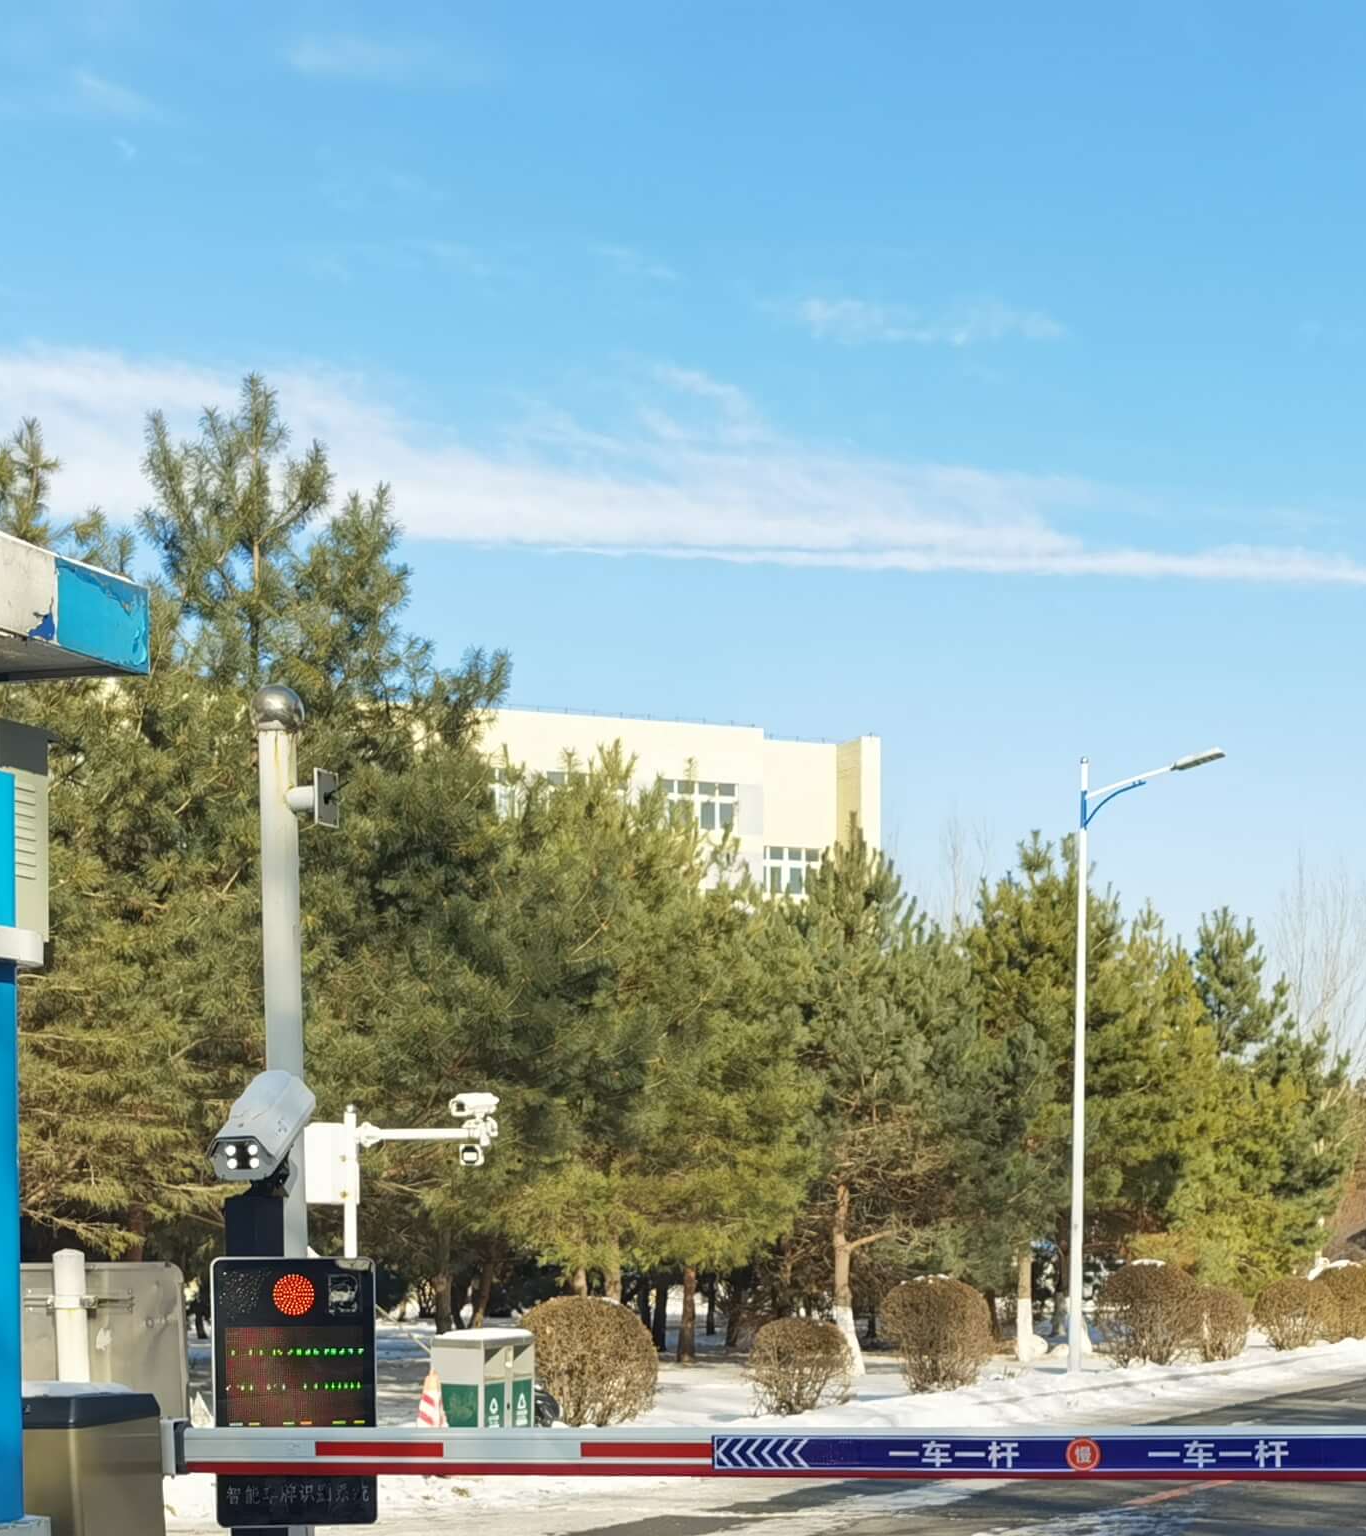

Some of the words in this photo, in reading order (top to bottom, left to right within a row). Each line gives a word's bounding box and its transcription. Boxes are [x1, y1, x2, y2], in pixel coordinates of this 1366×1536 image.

[889, 1440, 1019, 1468] 一车一杆
[1075, 1446, 1093, 1464] 慢
[1148, 1440, 1289, 1468] 一车一杆
